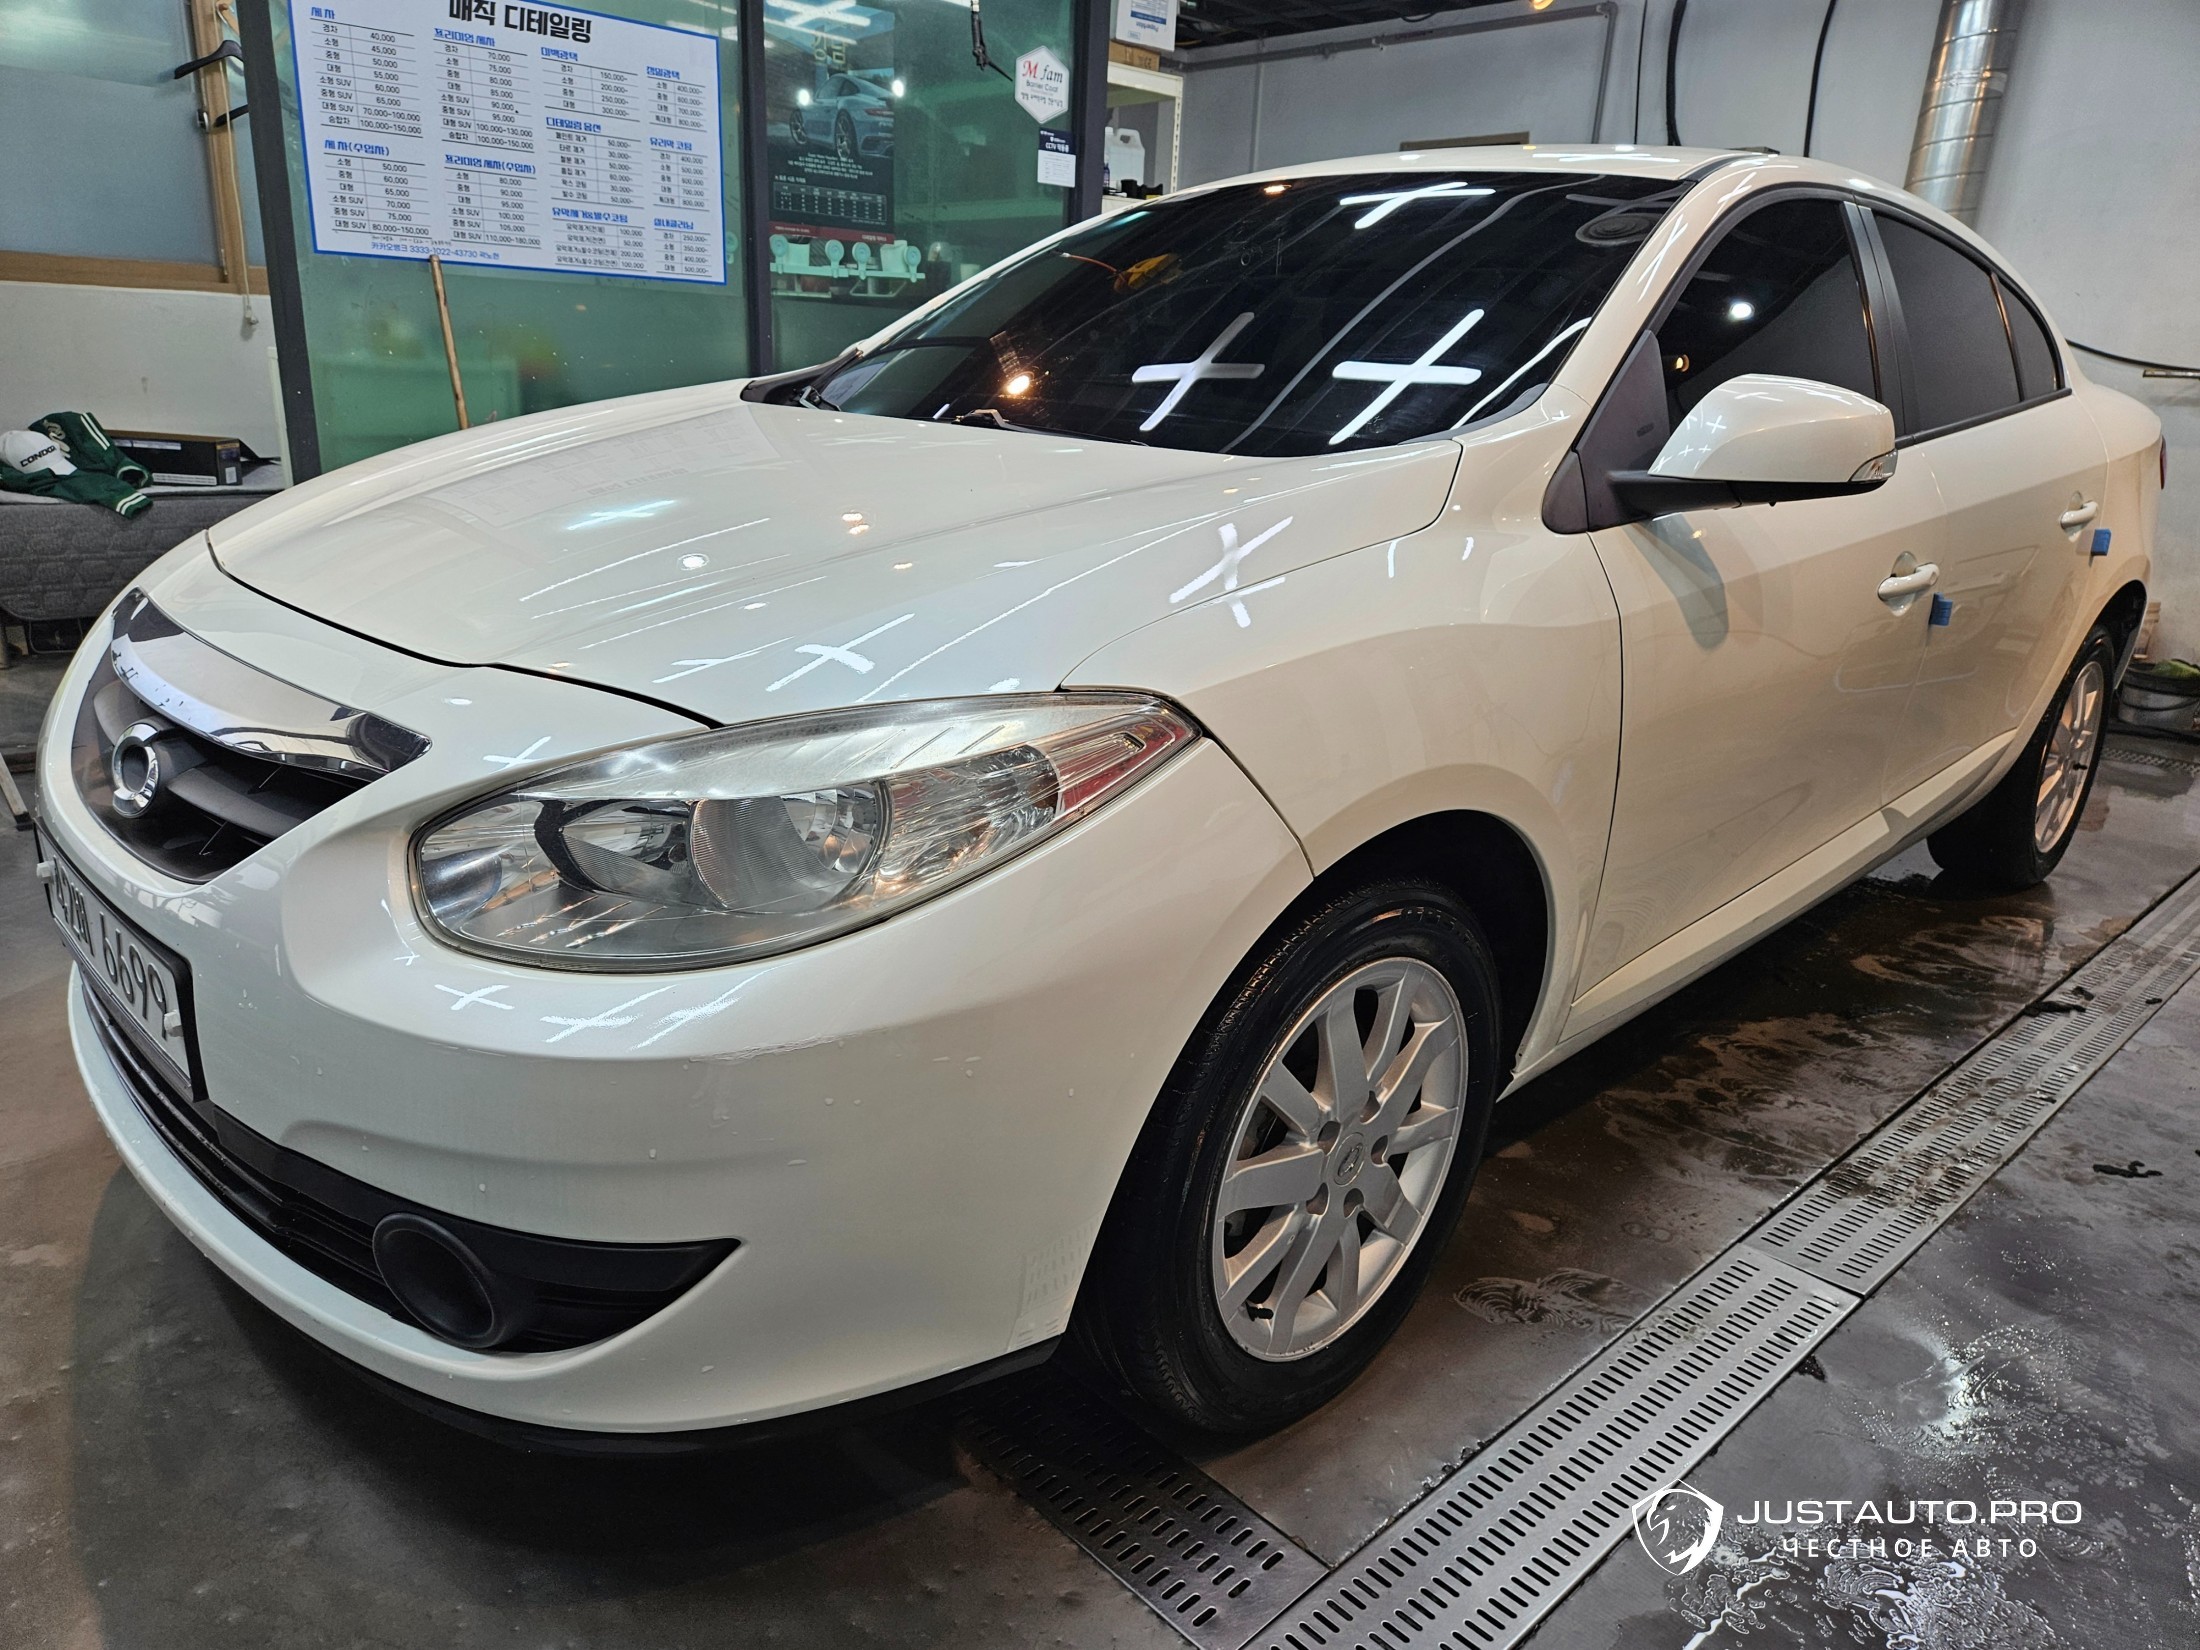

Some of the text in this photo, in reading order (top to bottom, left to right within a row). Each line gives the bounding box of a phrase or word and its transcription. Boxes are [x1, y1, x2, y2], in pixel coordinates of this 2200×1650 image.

[449, 0, 591, 43] 매직 디테일링
[323, 24, 395, 42] 경차 40,000
[434, 28, 474, 43] 프리미엄
[325, 38, 396, 55] 소형 45,000
[445, 44, 510, 62] 경차 70,000
[326, 51, 397, 68] 중형 50,000
[446, 58, 511, 74] 소형 75,000
[327, 64, 399, 81] 대형 55,000
[447, 70, 512, 86] 중형 80,000
[1023, 60, 1063, 83] M fam
[320, 76, 334, 85] 소형
[375, 84, 400, 93] 60,000
[448, 82, 513, 98] 대형 85,000
[321, 89, 335, 98] 중형
[376, 97, 401, 106] 65,000
[441, 94, 514, 111] 소형 SUV 90,000
[322, 102, 336, 110] 대형
[339, 104, 354, 112] SUV
[564, 101, 575, 109] 대형
[329, 116, 350, 124] 승합차
[442, 106, 515, 123] 중형 SUV 95,000
[443, 118, 456, 127] 대형
[458, 120, 471, 128] SUV
[449, 132, 468, 140] 승합차
[337, 158, 407, 172] 소형 50,000
[445, 154, 482, 167] 프리미엄
[339, 170, 408, 185] 중형 60,000
[457, 172, 469, 180] 소형
[340, 183, 409, 197] 대형 65,000
[500, 189, 522, 197] 90,000
[333, 195, 346, 203] 소형
[386, 201, 410, 209] 70,000
[458, 196, 523, 209] 대형 95,000
[334, 207, 347, 216] 중형
[388, 213, 412, 221] 75,000
[499, 212, 524, 220] 100,000
[335, 220, 349, 228] 대형
[454, 231, 466, 239] 대형
[371, 242, 407, 252] 카카오뱅크
[99, 911, 169, 1042] 6699
